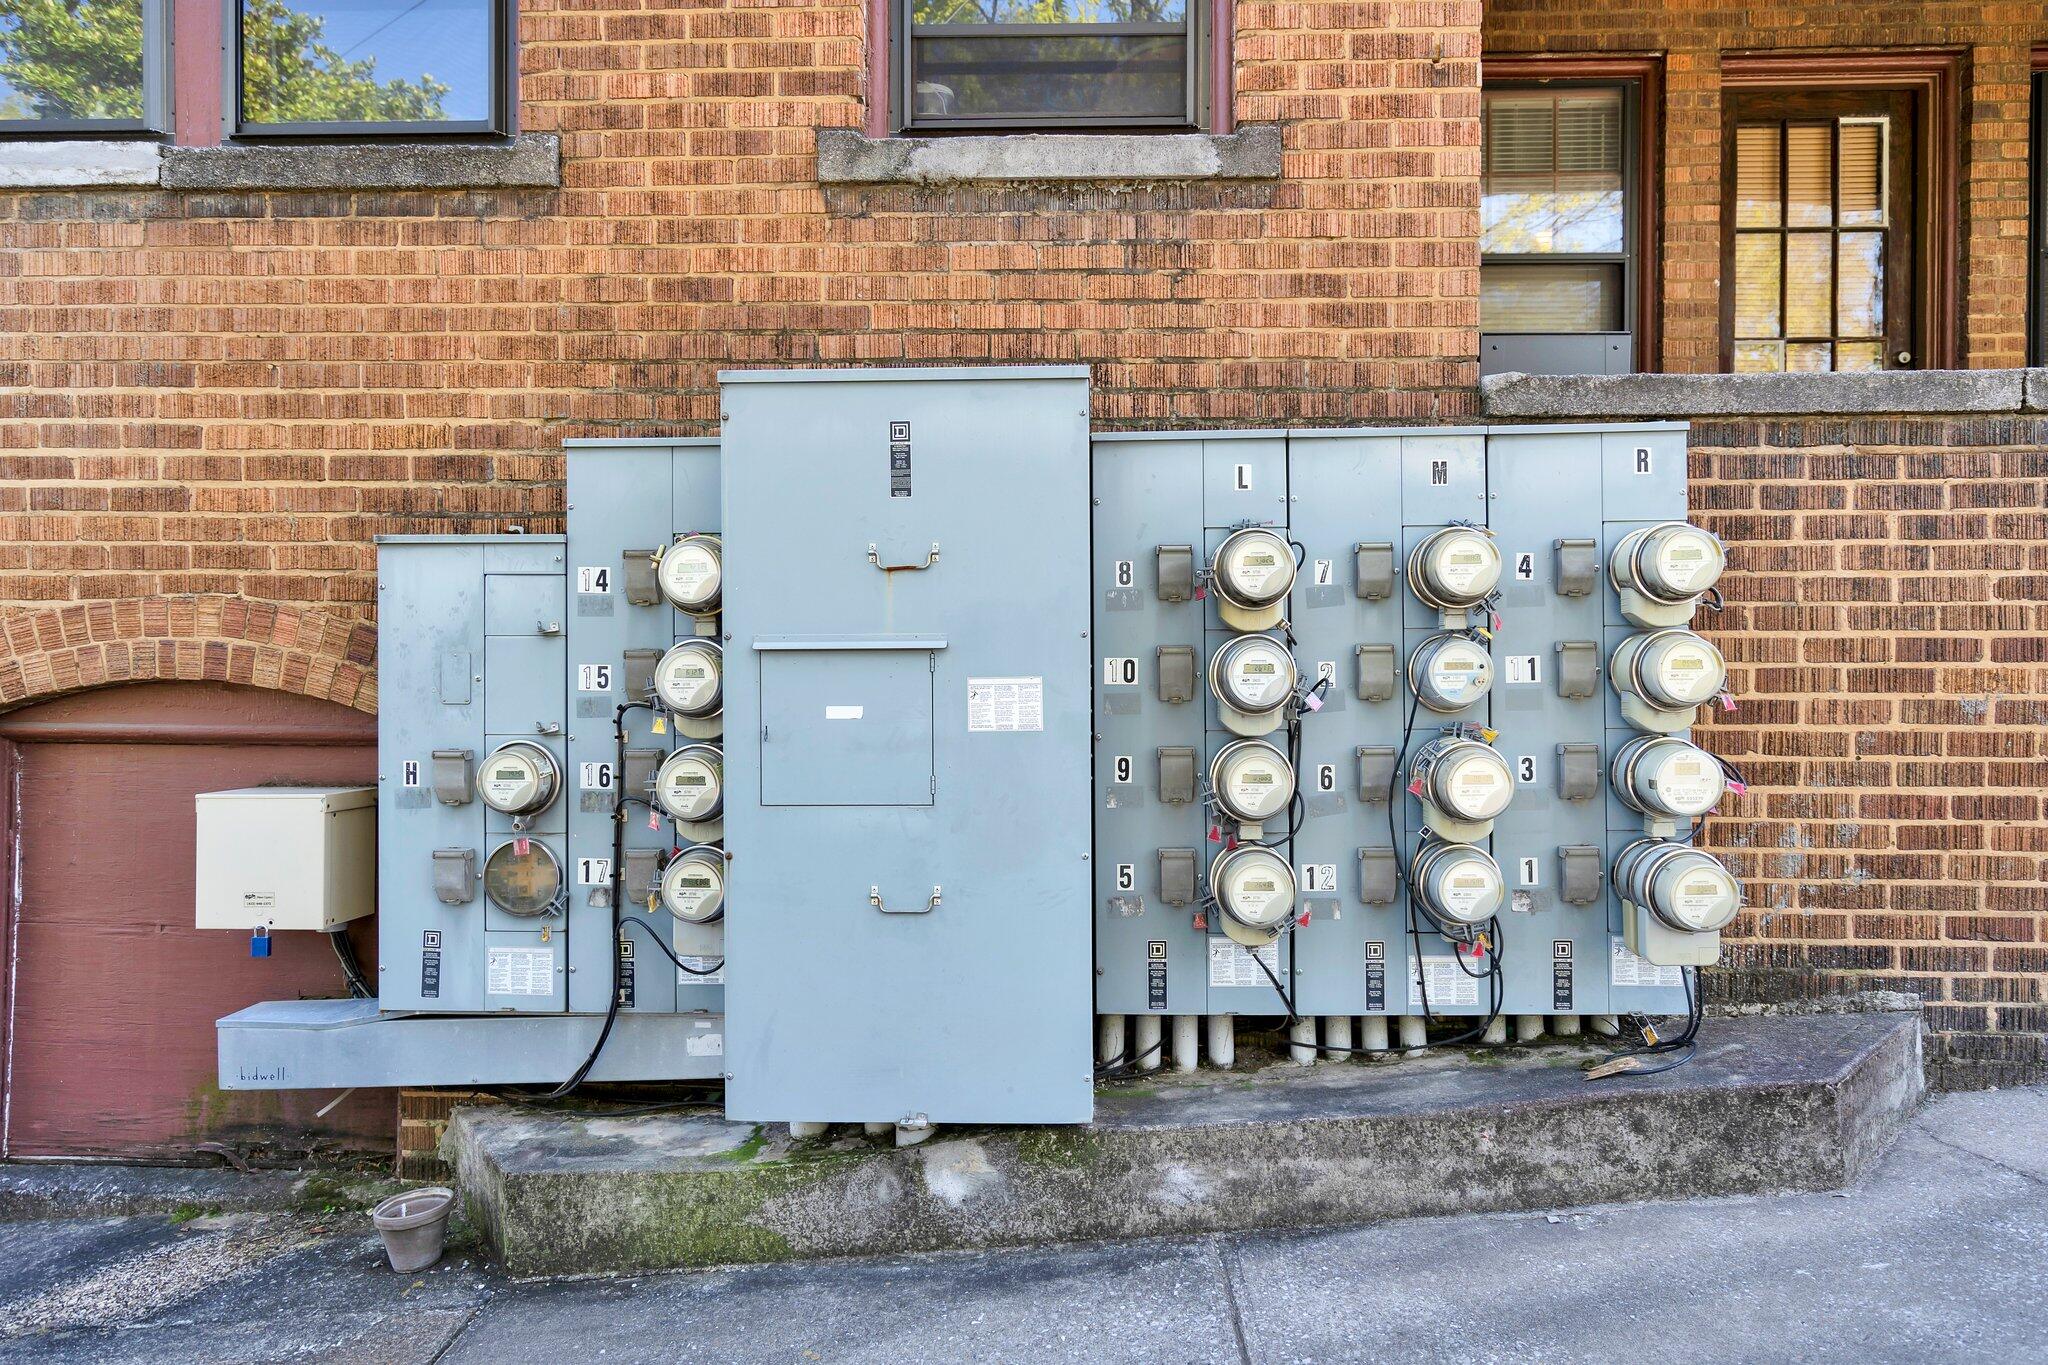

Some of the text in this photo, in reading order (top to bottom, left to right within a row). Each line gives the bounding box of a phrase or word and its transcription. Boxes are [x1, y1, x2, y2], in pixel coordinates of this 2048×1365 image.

[1637, 449, 1648, 472] R
[1238, 466, 1248, 489] L
[1433, 462, 1447, 484] M
[1119, 562, 1131, 585] 8
[1318, 561, 1329, 583] 7
[1519, 555, 1531, 578] 4
[583, 569, 608, 591] 14
[584, 666, 608, 689] 15
[1110, 659, 1135, 683] 10
[1319, 664, 1333, 687] 2
[1511, 658, 1535, 680] 11
[405, 763, 416, 785] H
[586, 764, 610, 787] 16
[1118, 758, 1129, 781] 9
[1321, 766, 1332, 790] 6
[1522, 758, 1533, 781] 3
[583, 860, 608, 882] 17
[1120, 866, 1131, 888] 5
[1307, 867, 1334, 889] 12
[1525, 860, 1534, 883] 1
[240, 1066, 285, 1081] bidwell
